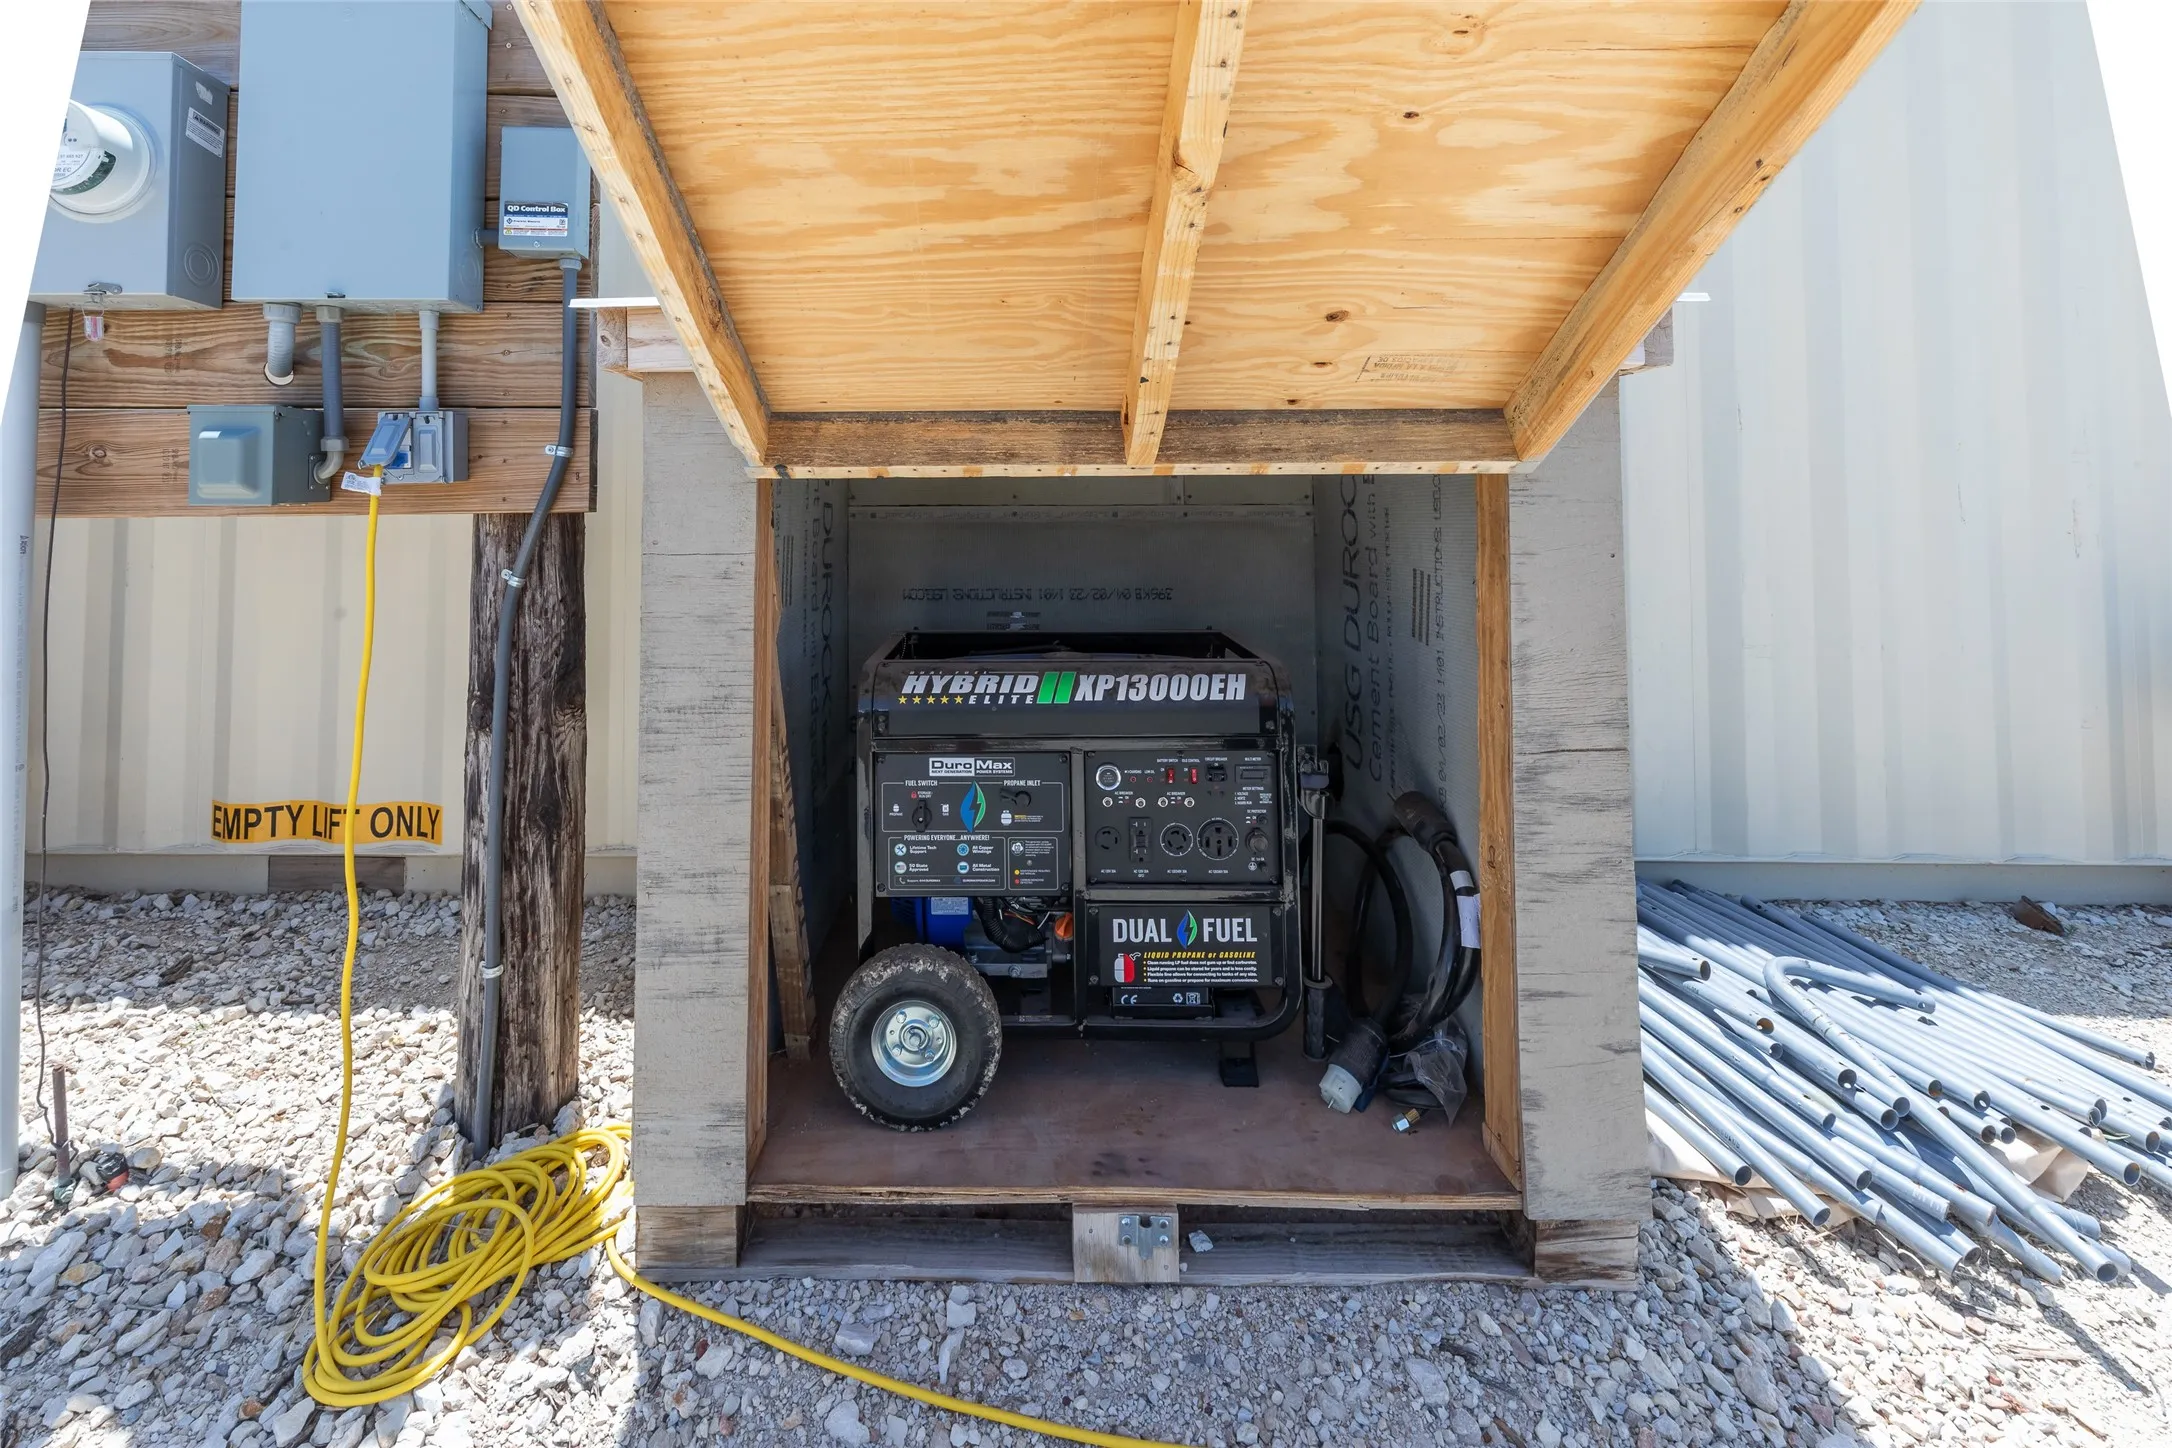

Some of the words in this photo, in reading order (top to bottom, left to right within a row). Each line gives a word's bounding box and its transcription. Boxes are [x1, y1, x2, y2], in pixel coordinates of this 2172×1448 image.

[1365, 493, 1377, 542] with
[811, 518, 821, 611] Board
[1340, 474, 1362, 653] DUROC
[1365, 546, 1380, 644] Board
[901, 675, 1039, 694] HYBRID
[1074, 674, 1246, 701] XP13000EH
[968, 695, 1034, 704] ELITE
[1344, 666, 1363, 770] USG
[1366, 655, 1381, 783] Cement
[931, 761, 1012, 769] DuroMax
[212, 804, 304, 840] EMPTY
[312, 805, 360, 839] LIF
[370, 805, 440, 840] ONLY
[1113, 918, 1172, 943] DUAL
[1203, 918, 1258, 942] FUEL
